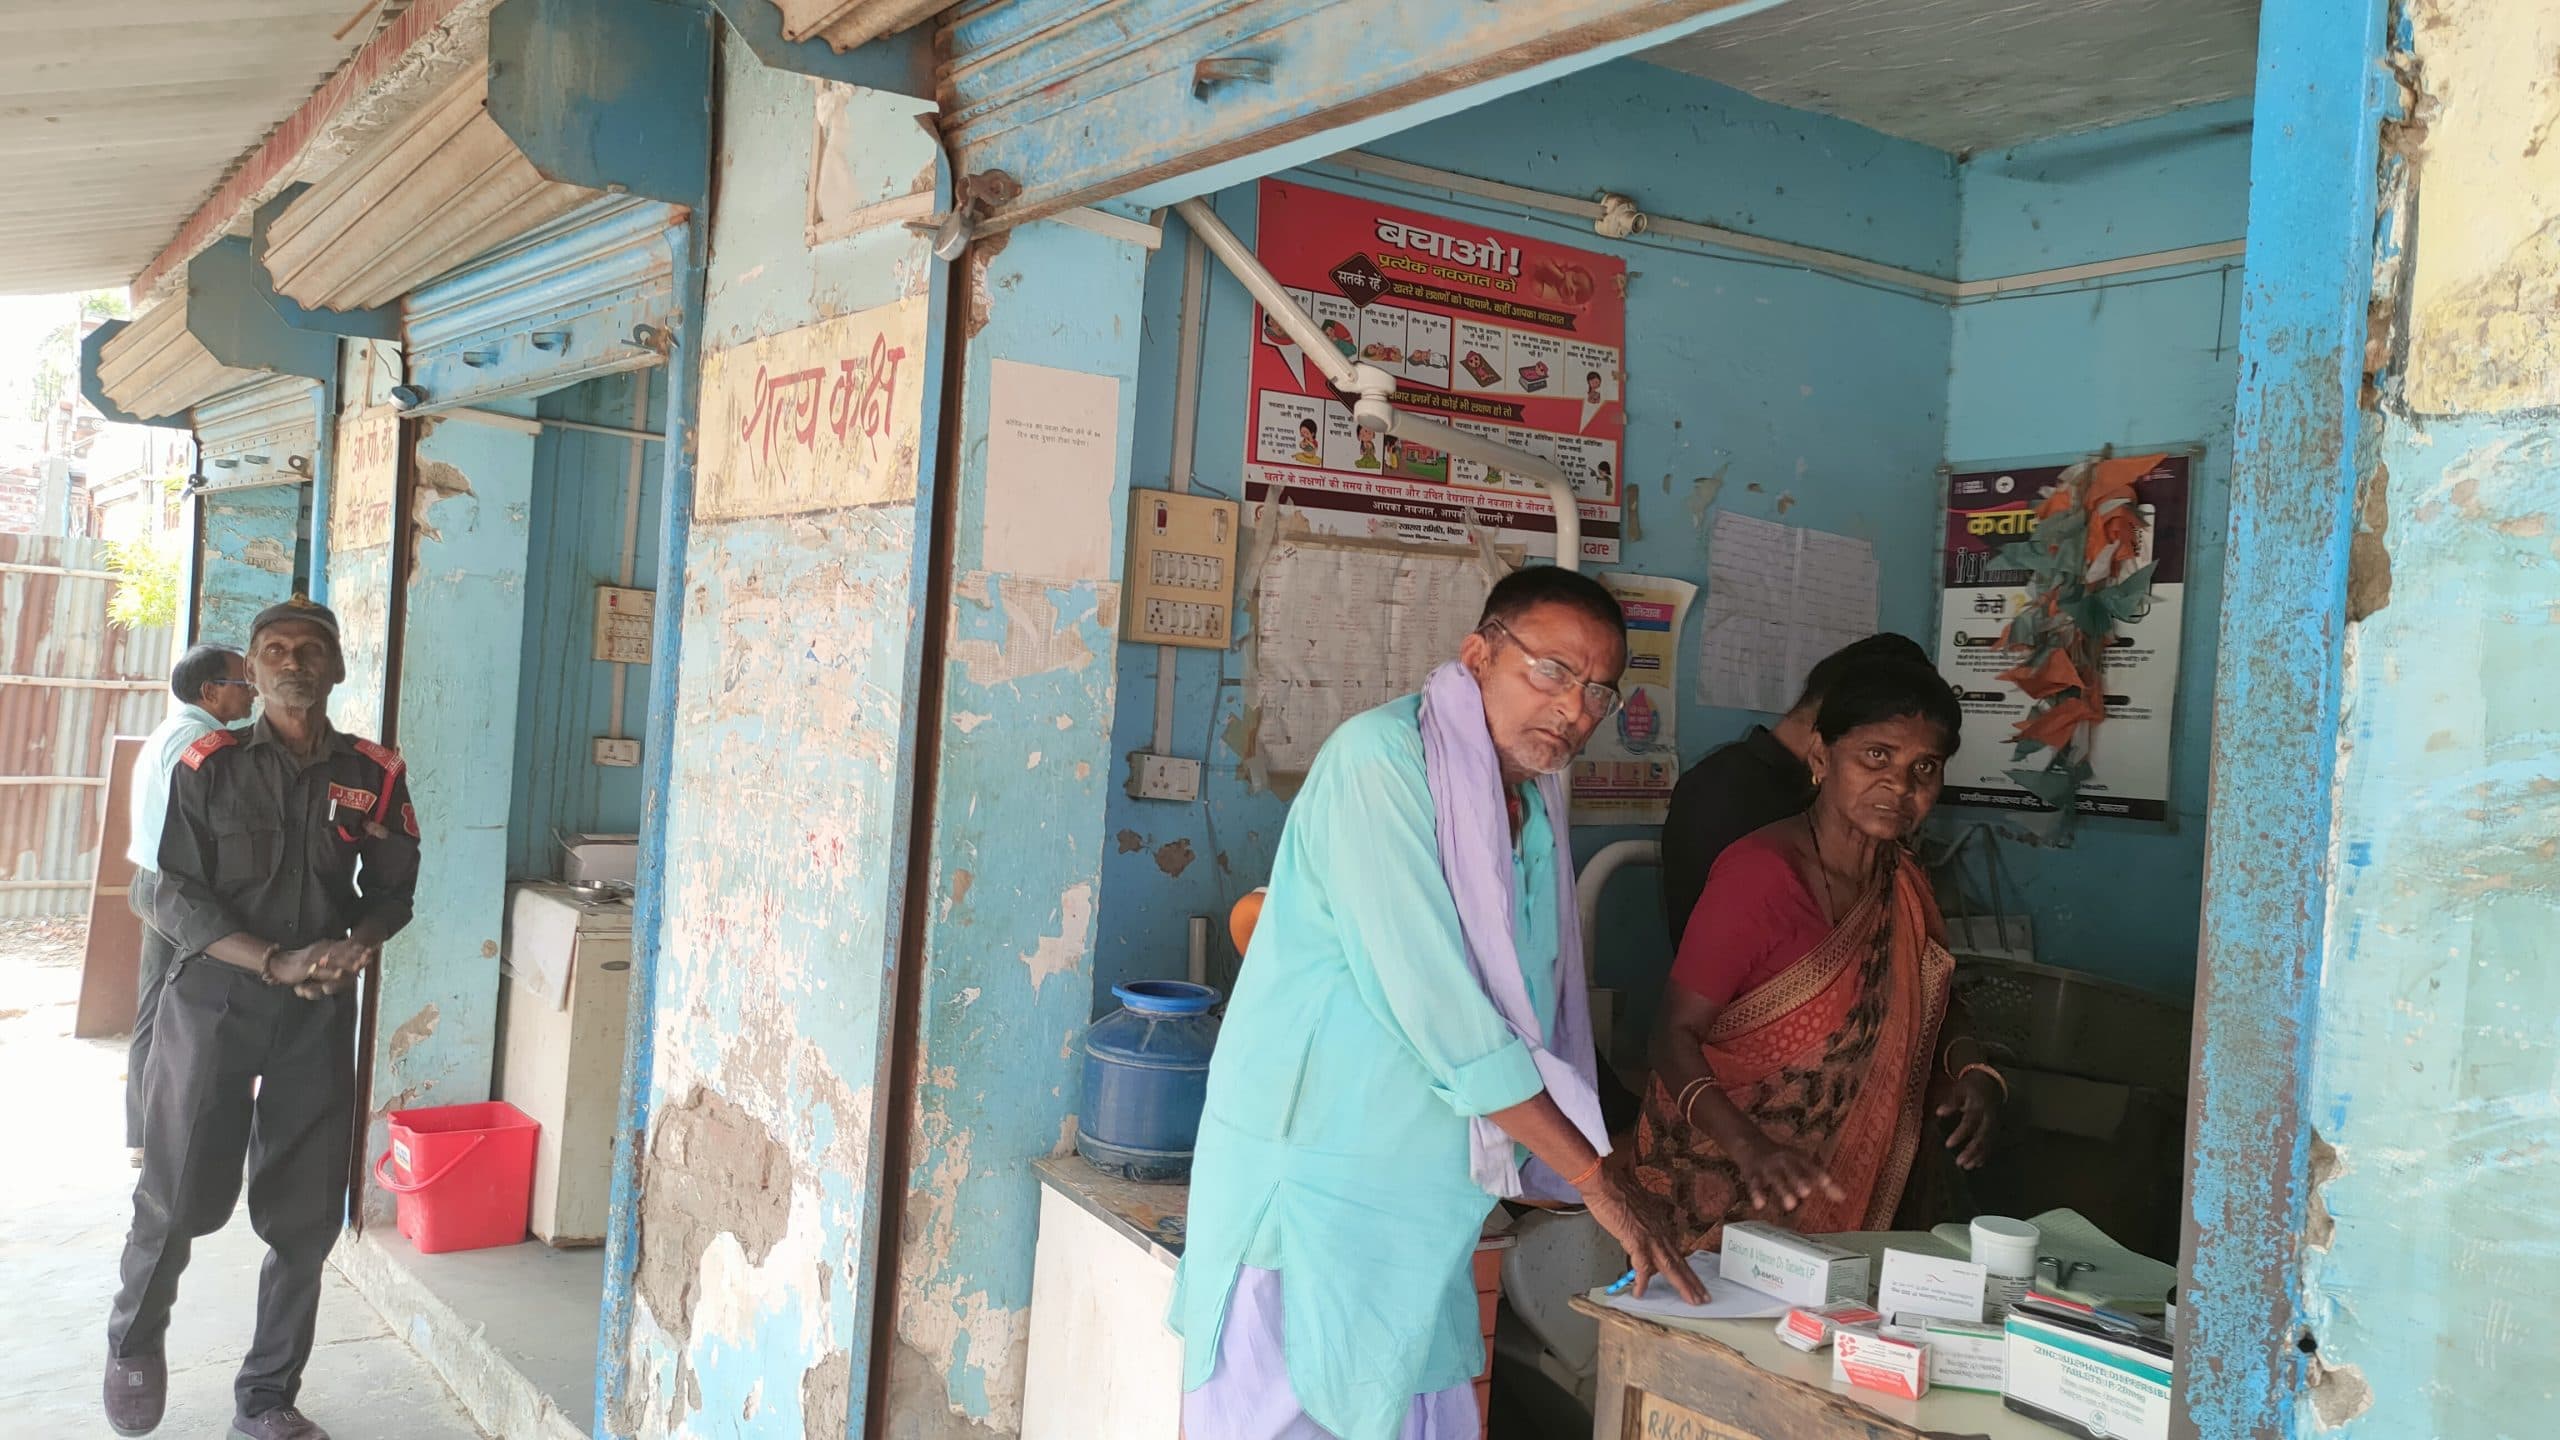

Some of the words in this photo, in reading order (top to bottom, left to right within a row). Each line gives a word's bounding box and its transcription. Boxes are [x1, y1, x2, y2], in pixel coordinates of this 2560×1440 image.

[1338, 269, 1365, 288] सतर्क
[1377, 253, 1428, 275] प्रत्येक
[1432, 265, 1491, 288] नवजात
[1496, 277, 1517, 293] को
[1393, 283, 1413, 296] खतरे
[1414, 286, 1424, 299] के
[1264, 471, 1285, 484] खतरे
[1288, 473, 1296, 485] के
[1300, 475, 1325, 488] लक्षणों
[1343, 481, 1362, 492] समय
[1365, 481, 1372, 493] से
[1375, 484, 1402, 497] पहचान
[1405, 484, 1420, 498] और
[1487, 498, 1514, 510] नवजात
[1516, 499, 1523, 511] के
[1525, 500, 1546, 513] जीवन
[1372, 501, 1402, 513] आपका
[1505, 513, 1514, 525] में
[1584, 543, 1610, 556] care
[2109, 1369, 2170, 1401] DISPERSIBL
